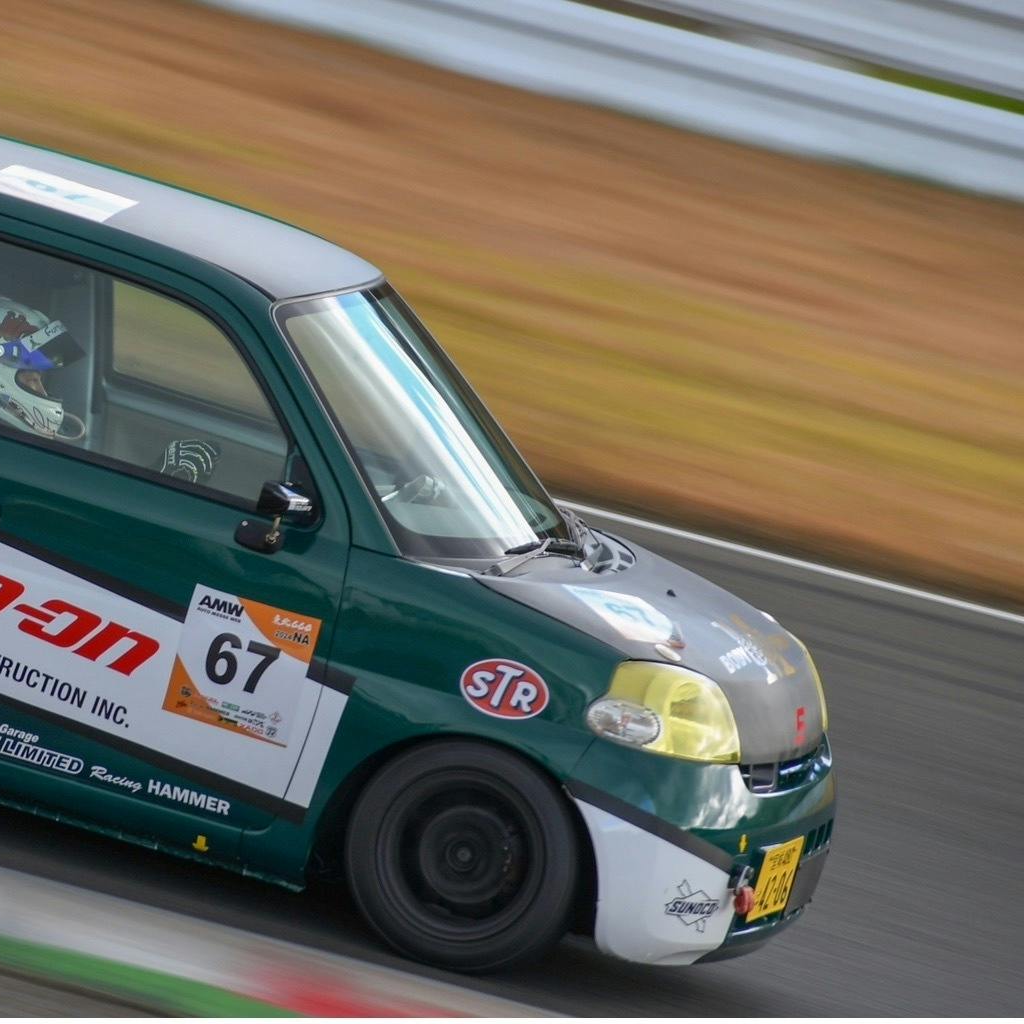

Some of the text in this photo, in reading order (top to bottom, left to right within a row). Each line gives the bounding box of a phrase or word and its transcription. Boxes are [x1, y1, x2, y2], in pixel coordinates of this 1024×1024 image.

[198, 594, 245, 618] AMW
[292, 631, 311, 646] NA
[205, 632, 282, 694] 67
[466, 664, 539, 714] STR
[90, 696, 130, 728] INC.
[0, 737, 85, 775] LIMITED
[88, 764, 231, 816] Racing HAMMER
[668, 900, 716, 916] SUNOCO
